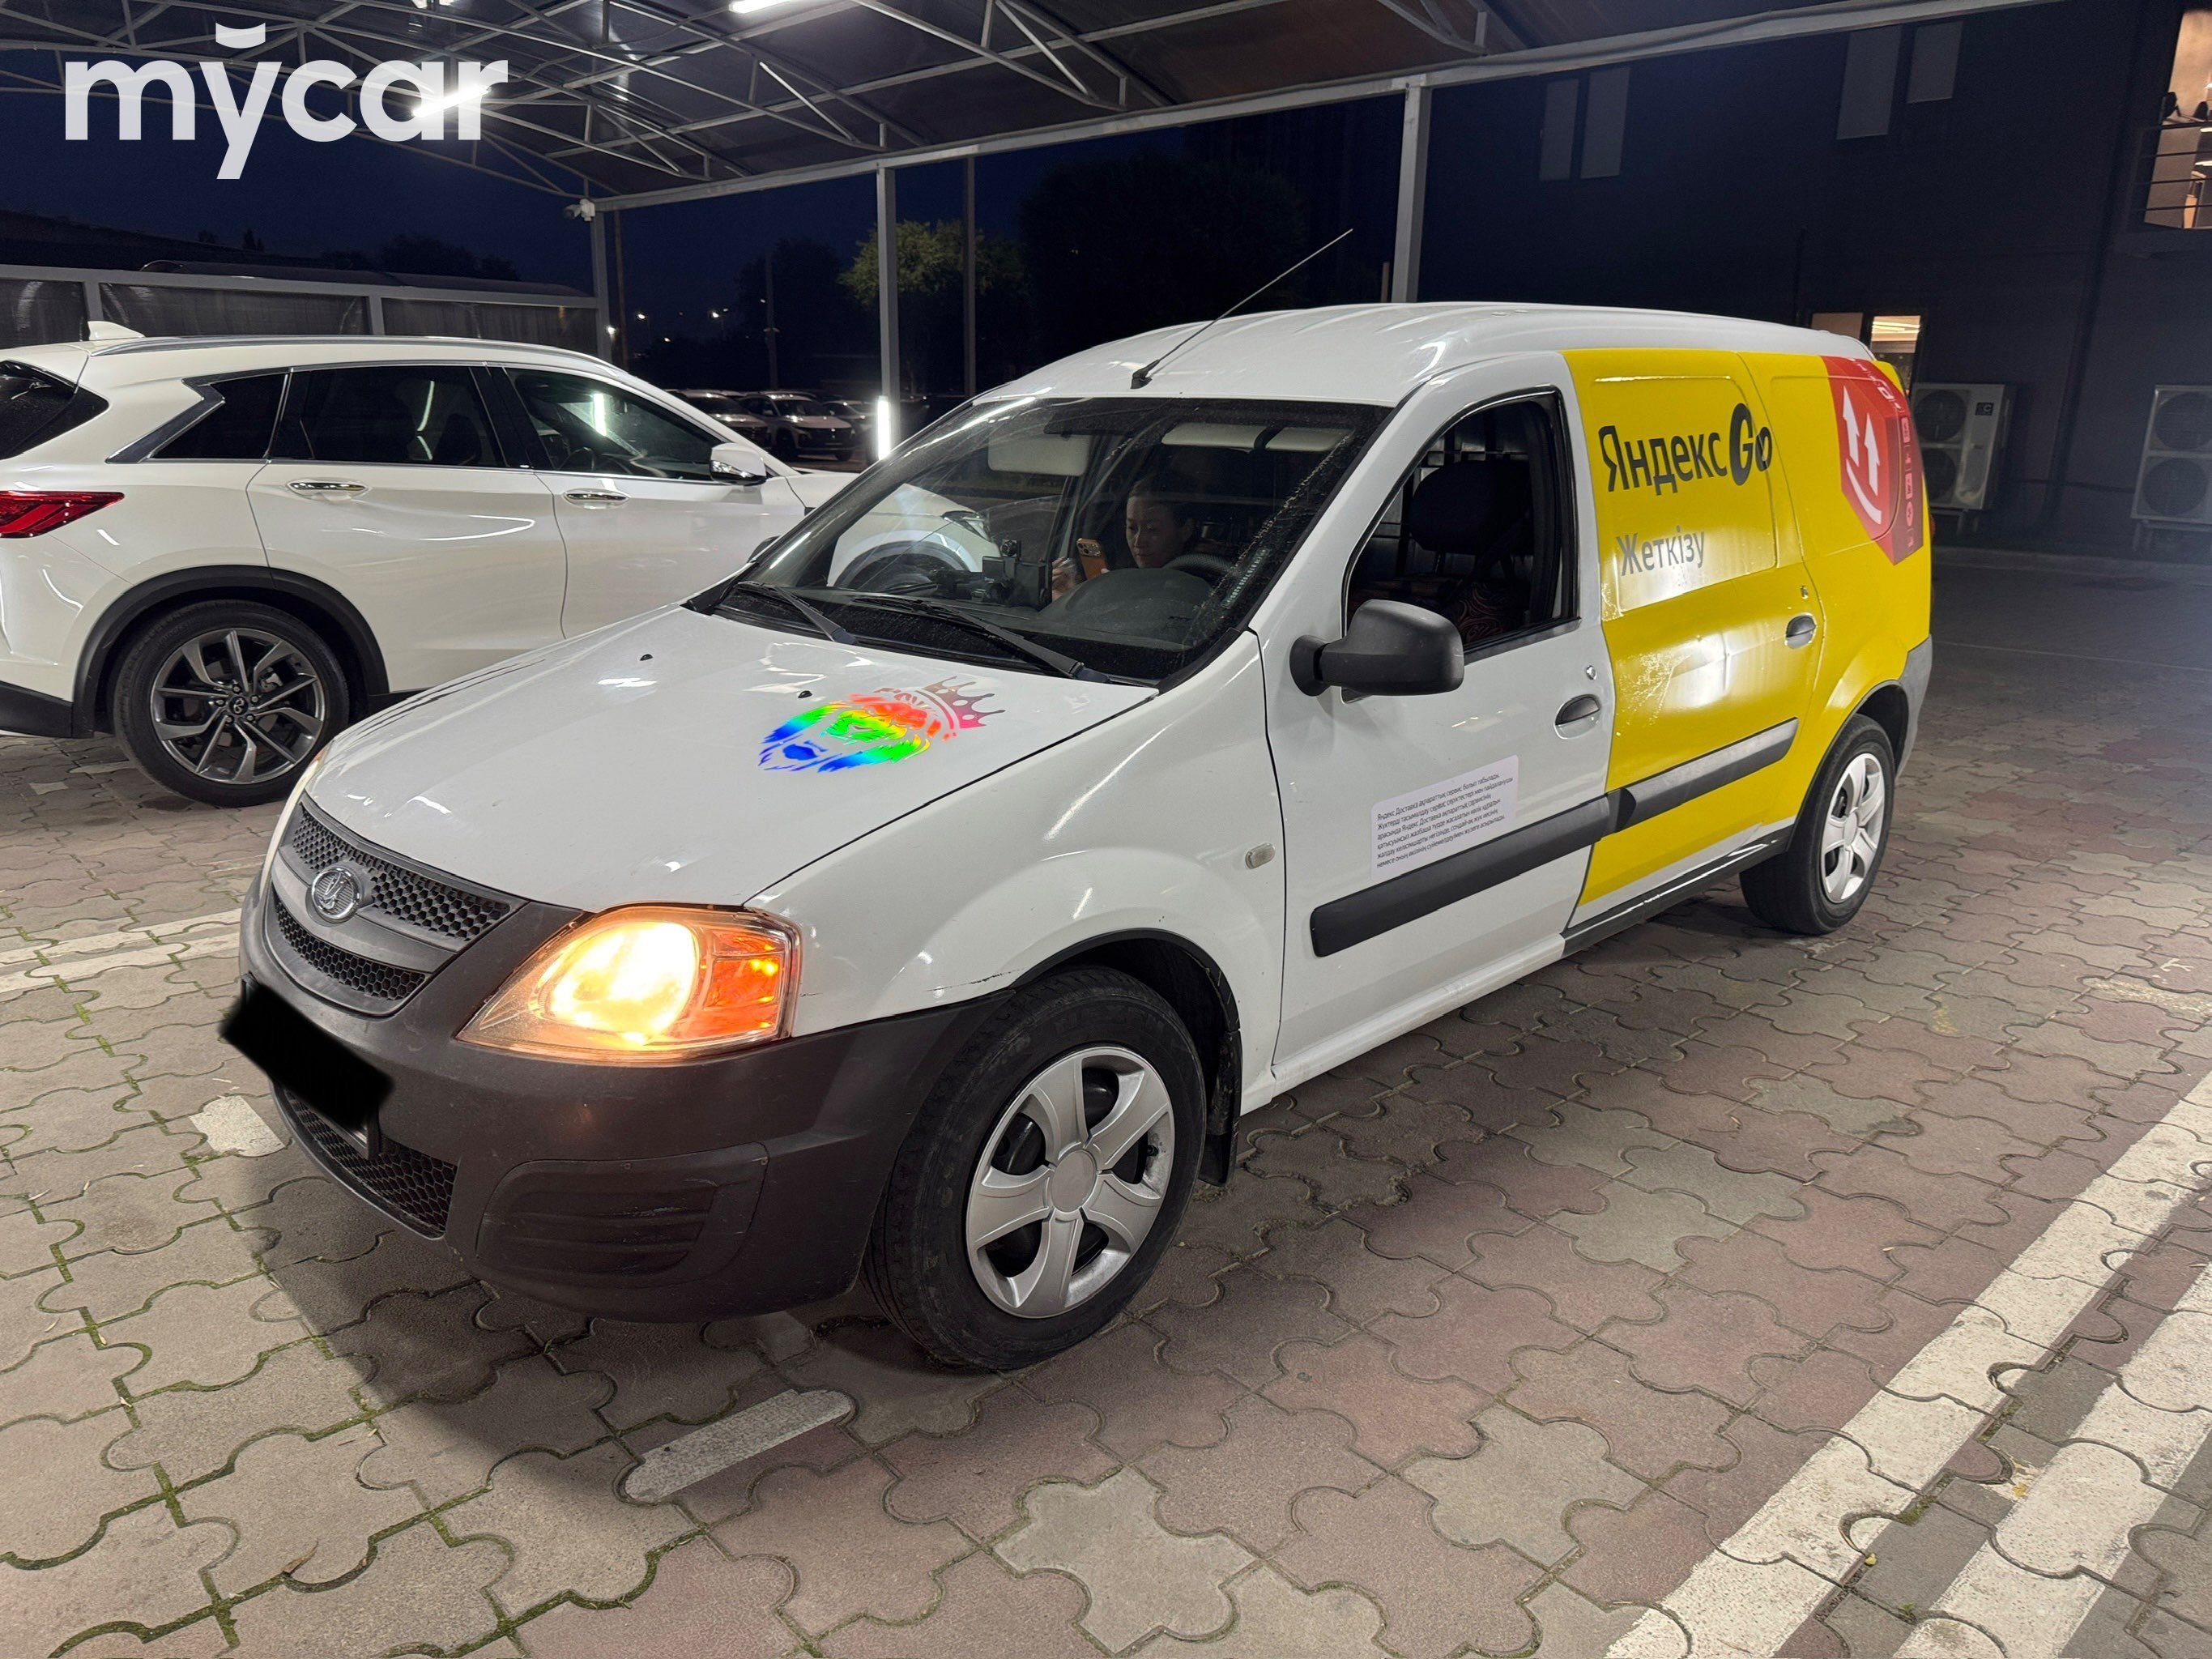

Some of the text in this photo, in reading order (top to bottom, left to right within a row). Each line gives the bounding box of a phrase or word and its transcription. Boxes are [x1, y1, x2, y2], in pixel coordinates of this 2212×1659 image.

[1598, 403, 1773, 496] Яндекс Go
[1616, 525, 1705, 576] Жеткізу
[1377, 811, 1394, 821] Яндекс
[1396, 802, 1417, 816] Доставка
[1401, 821, 1418, 831] Яндекс
[1419, 813, 1441, 826] Доставка
